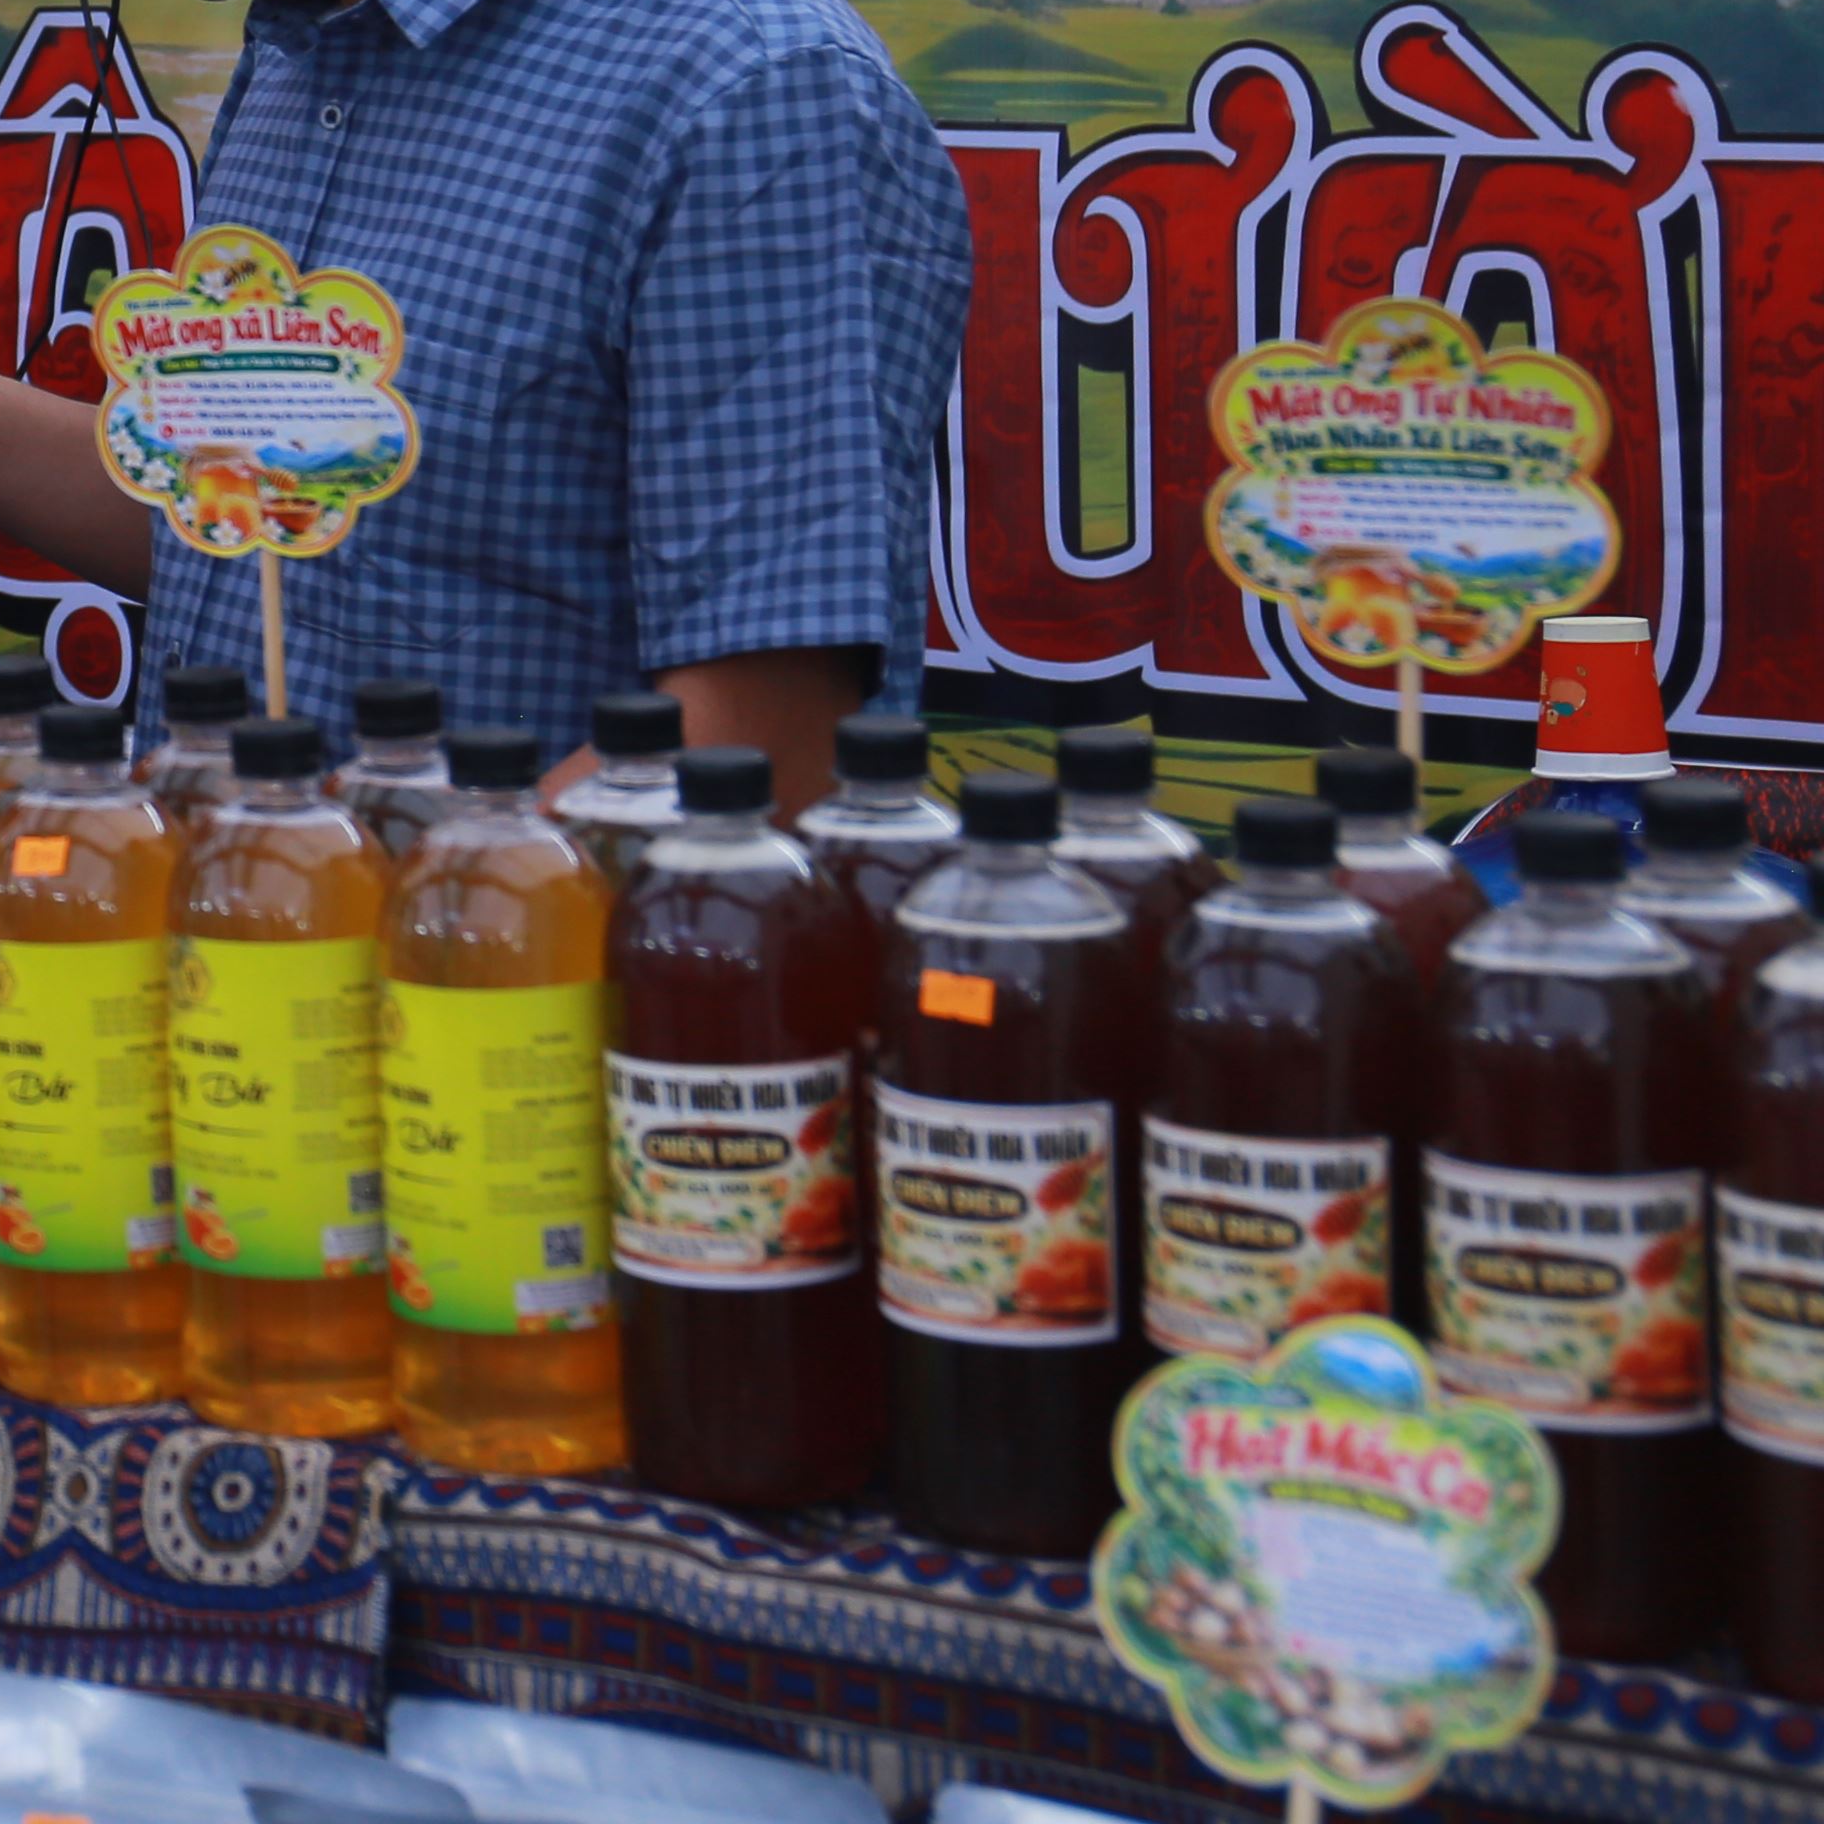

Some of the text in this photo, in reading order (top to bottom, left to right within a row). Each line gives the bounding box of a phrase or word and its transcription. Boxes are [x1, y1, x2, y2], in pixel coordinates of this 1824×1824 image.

[116, 307, 382, 359] Mật ong xã Liên Sơn
